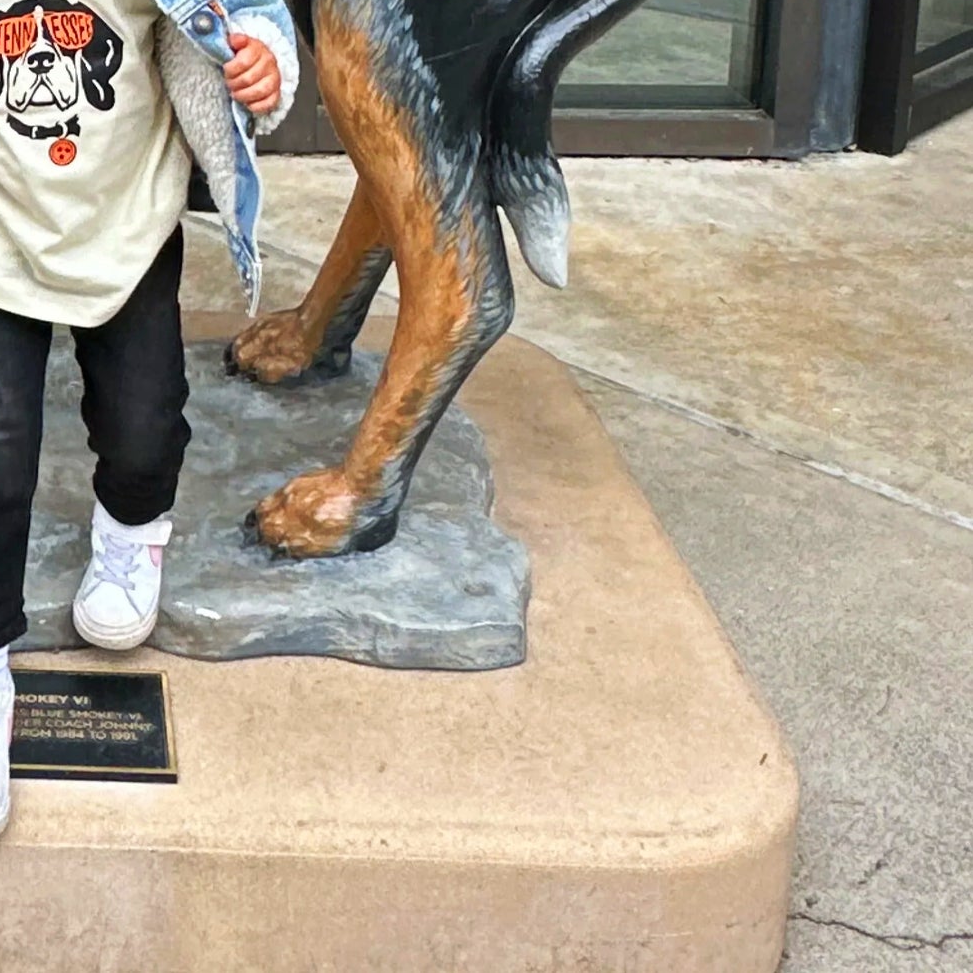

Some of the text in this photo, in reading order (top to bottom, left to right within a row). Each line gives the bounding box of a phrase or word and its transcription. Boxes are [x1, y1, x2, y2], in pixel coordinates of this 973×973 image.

[14, 694, 89, 705] MOKEY VI
[68, 710, 122, 720] SMOKEY
[45, 719, 92, 728] COACH
[90, 730, 106, 741] TO
